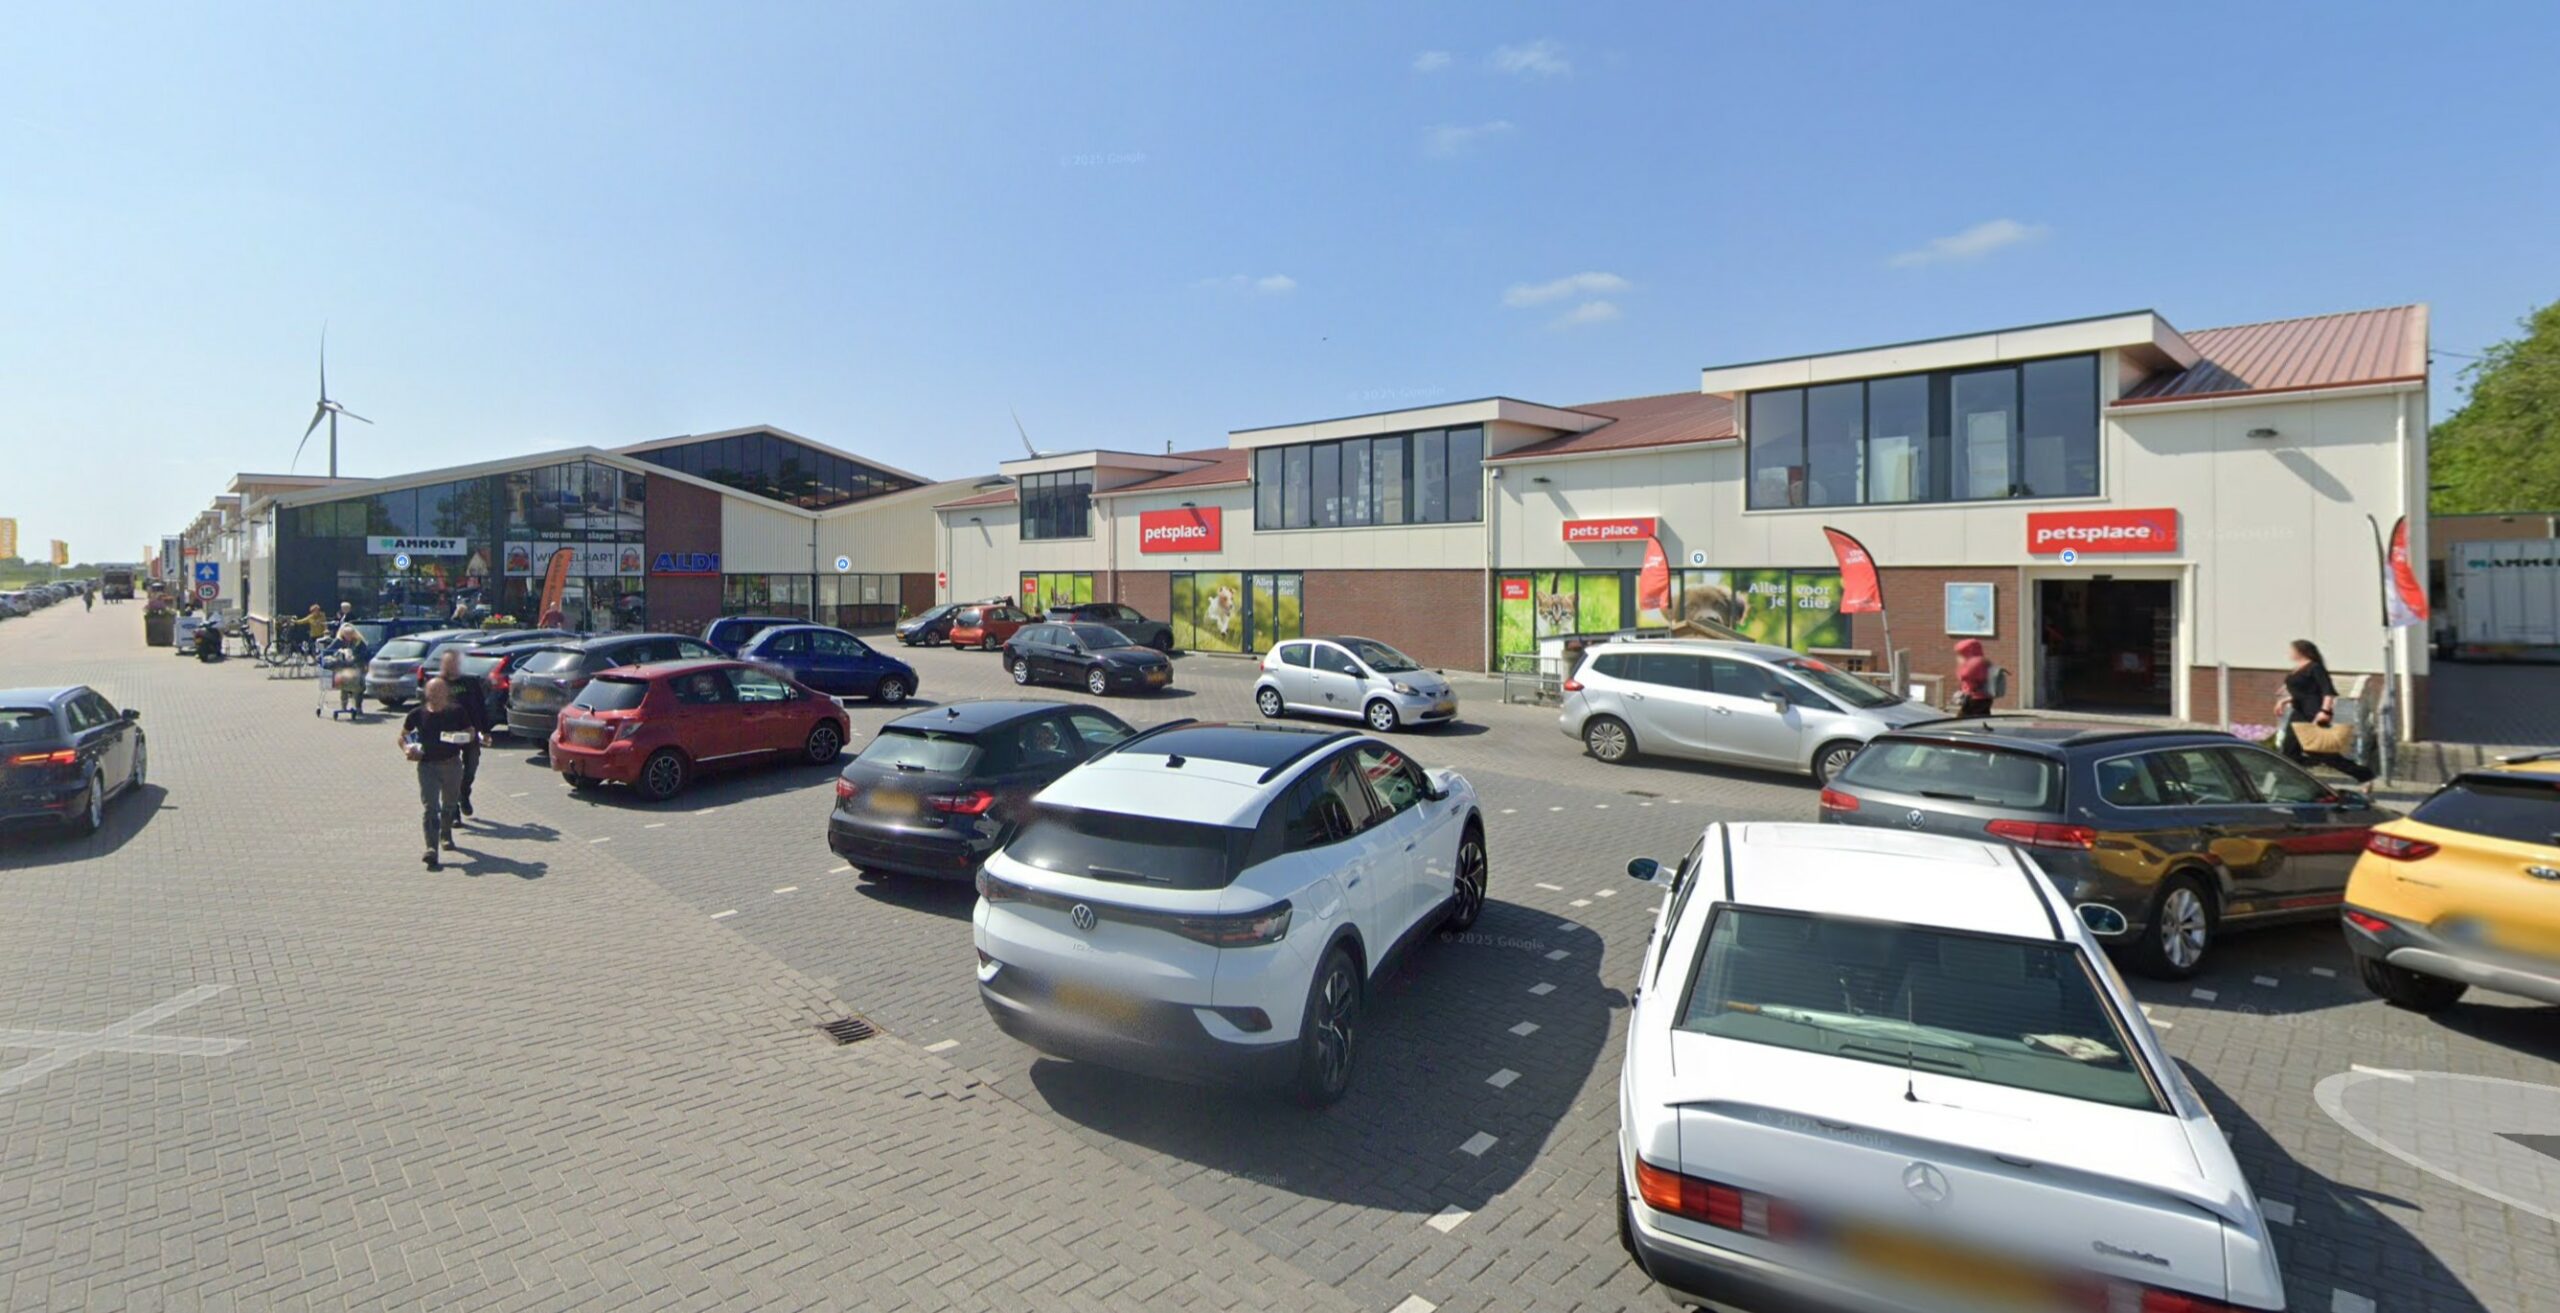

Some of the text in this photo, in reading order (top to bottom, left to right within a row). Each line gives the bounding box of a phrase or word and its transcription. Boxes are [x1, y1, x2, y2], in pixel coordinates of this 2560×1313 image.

[1145, 525, 1207, 543] petsplace
[1569, 525, 1639, 539] pets place
[2036, 524, 2151, 543] petsplace
[535, 553, 615, 562] WIELHART
[652, 552, 721, 571] ALDI
[201, 586, 214, 597] 15
[1749, 582, 1830, 596] Alles voor
[1770, 595, 1830, 609] je dier
